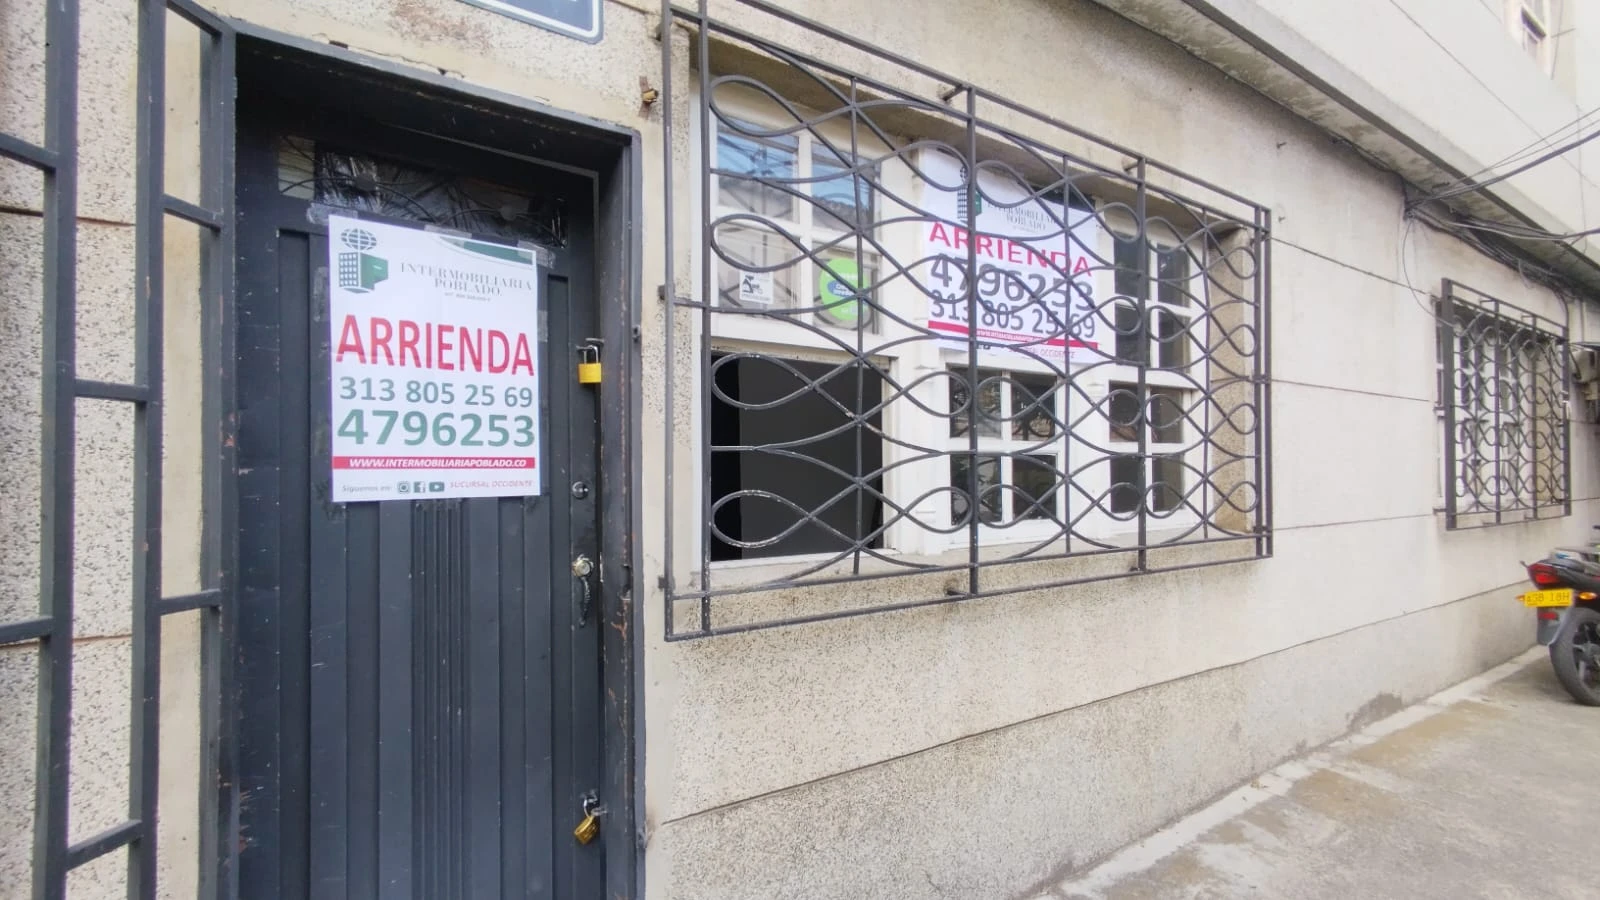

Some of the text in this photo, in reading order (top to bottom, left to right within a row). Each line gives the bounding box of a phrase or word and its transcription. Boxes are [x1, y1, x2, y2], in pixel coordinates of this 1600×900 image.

[929, 222, 1092, 277] ARRIENDA
[400, 263, 533, 291] INTERMOBILIARIA
[931, 253, 1094, 312] 4796253
[981, 299, 1024, 331] 805
[1032, 308, 1059, 336] 25
[1068, 313, 1095, 339] 69
[336, 314, 535, 376] ARRIENDA
[339, 376, 533, 408] 313 805 25 69
[337, 408, 536, 447] 4796253
[349, 457, 527, 469] WWW.INTERMOBILIARIAPOBLADO.CO
[449, 480, 490, 489] SUCURSAL
[491, 479, 533, 489] OCCIDENTE
